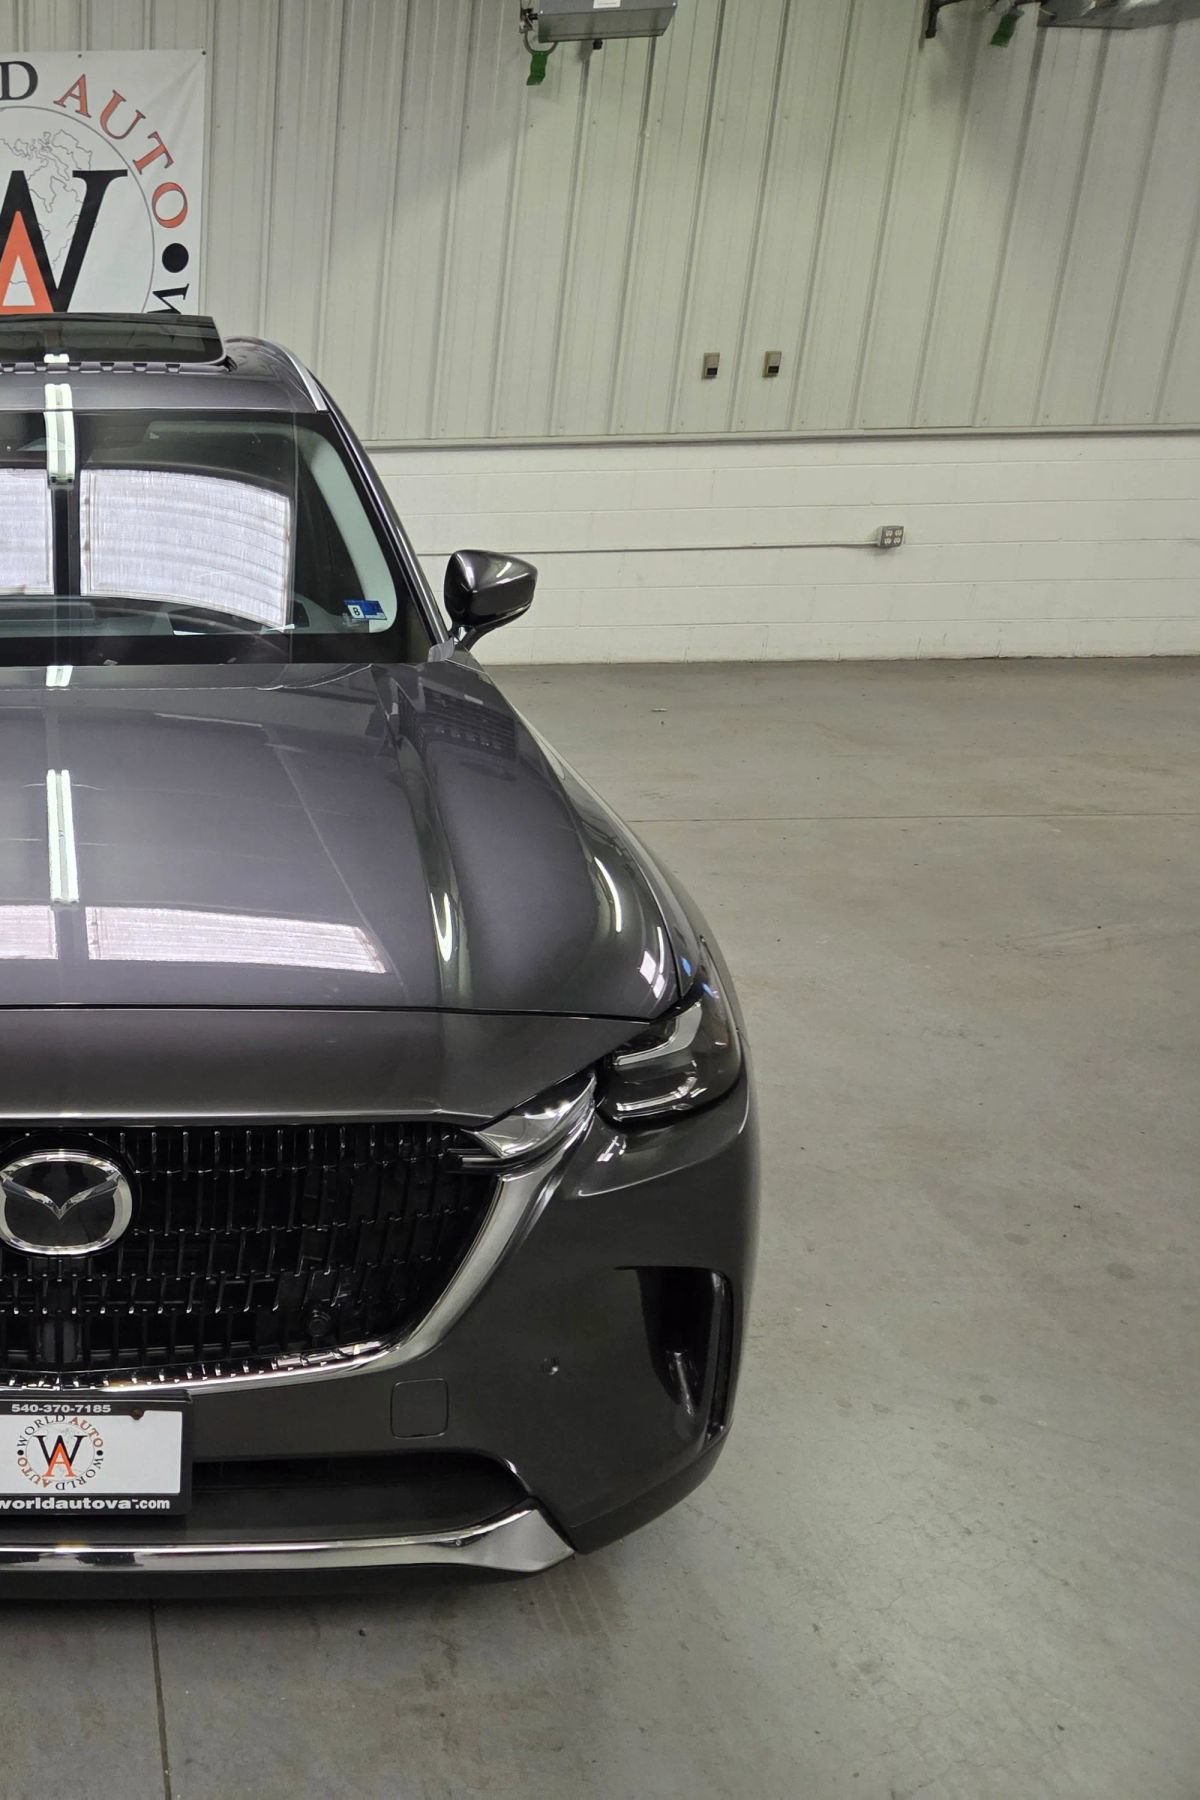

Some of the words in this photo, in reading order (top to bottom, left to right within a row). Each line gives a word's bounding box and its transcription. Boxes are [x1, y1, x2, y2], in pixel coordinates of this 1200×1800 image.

[53, 73, 189, 228] AUTO
[11, 1403, 112, 1413] 540-370-7185
[17, 1414, 65, 1447] WORLD
[69, 1416, 104, 1448] AUTO
[17, 1456, 53, 1488] AUTO
[55, 1457, 104, 1491] WORLD
